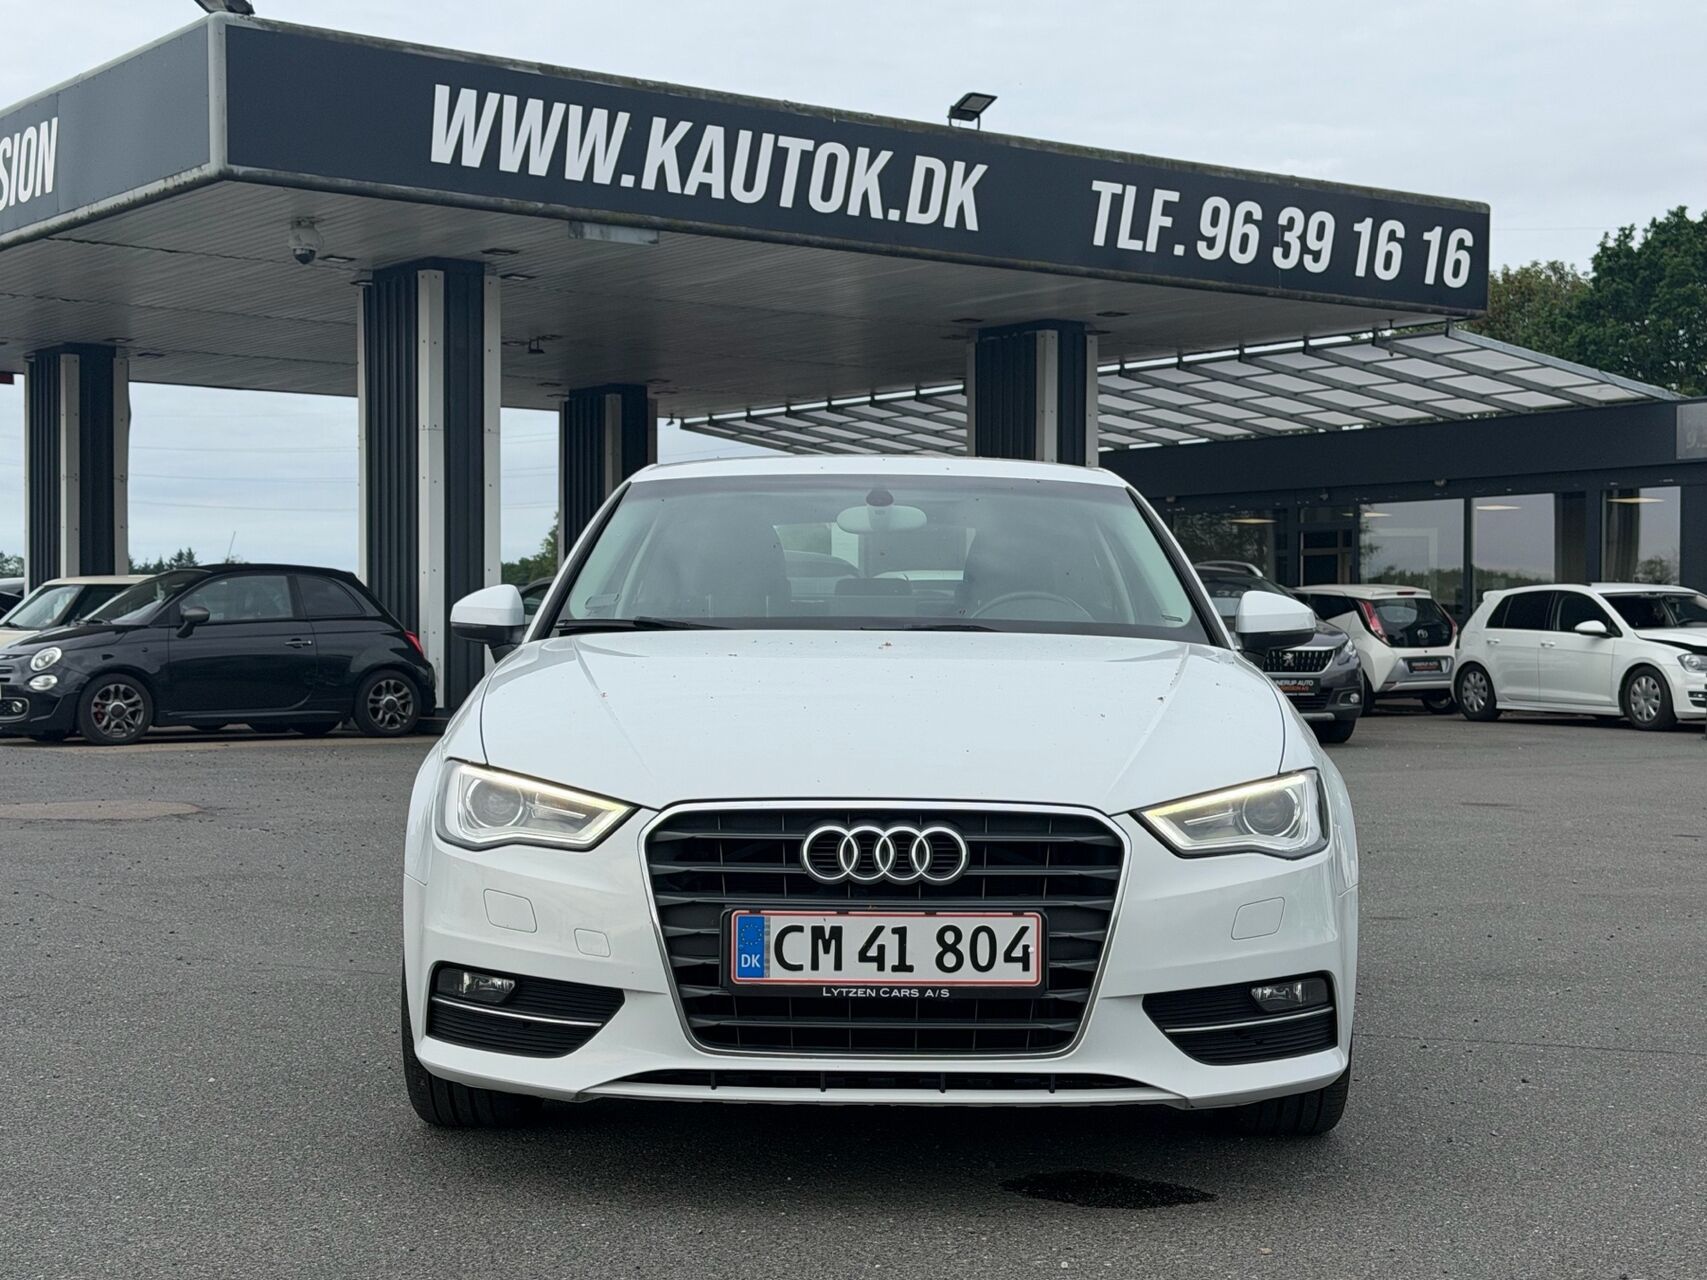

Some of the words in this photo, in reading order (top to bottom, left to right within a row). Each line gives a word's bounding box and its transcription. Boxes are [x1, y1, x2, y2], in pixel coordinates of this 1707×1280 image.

[430, 84, 988, 231] WWW.KAUTOK.DK
[1091, 180, 1185, 257] TLF.
[1197, 196, 1263, 264] 96
[1272, 207, 1336, 274] 39
[1353, 217, 1405, 281] 16
[1423, 225, 1474, 289] 16
[741, 953, 761, 969] DK
[773, 925, 843, 972] CM
[857, 925, 915, 973] 41
[934, 924, 1031, 973] 804
[822, 987, 875, 998] LYTZEN
[880, 987, 920, 998] CARS
[925, 987, 950, 998] A/S
